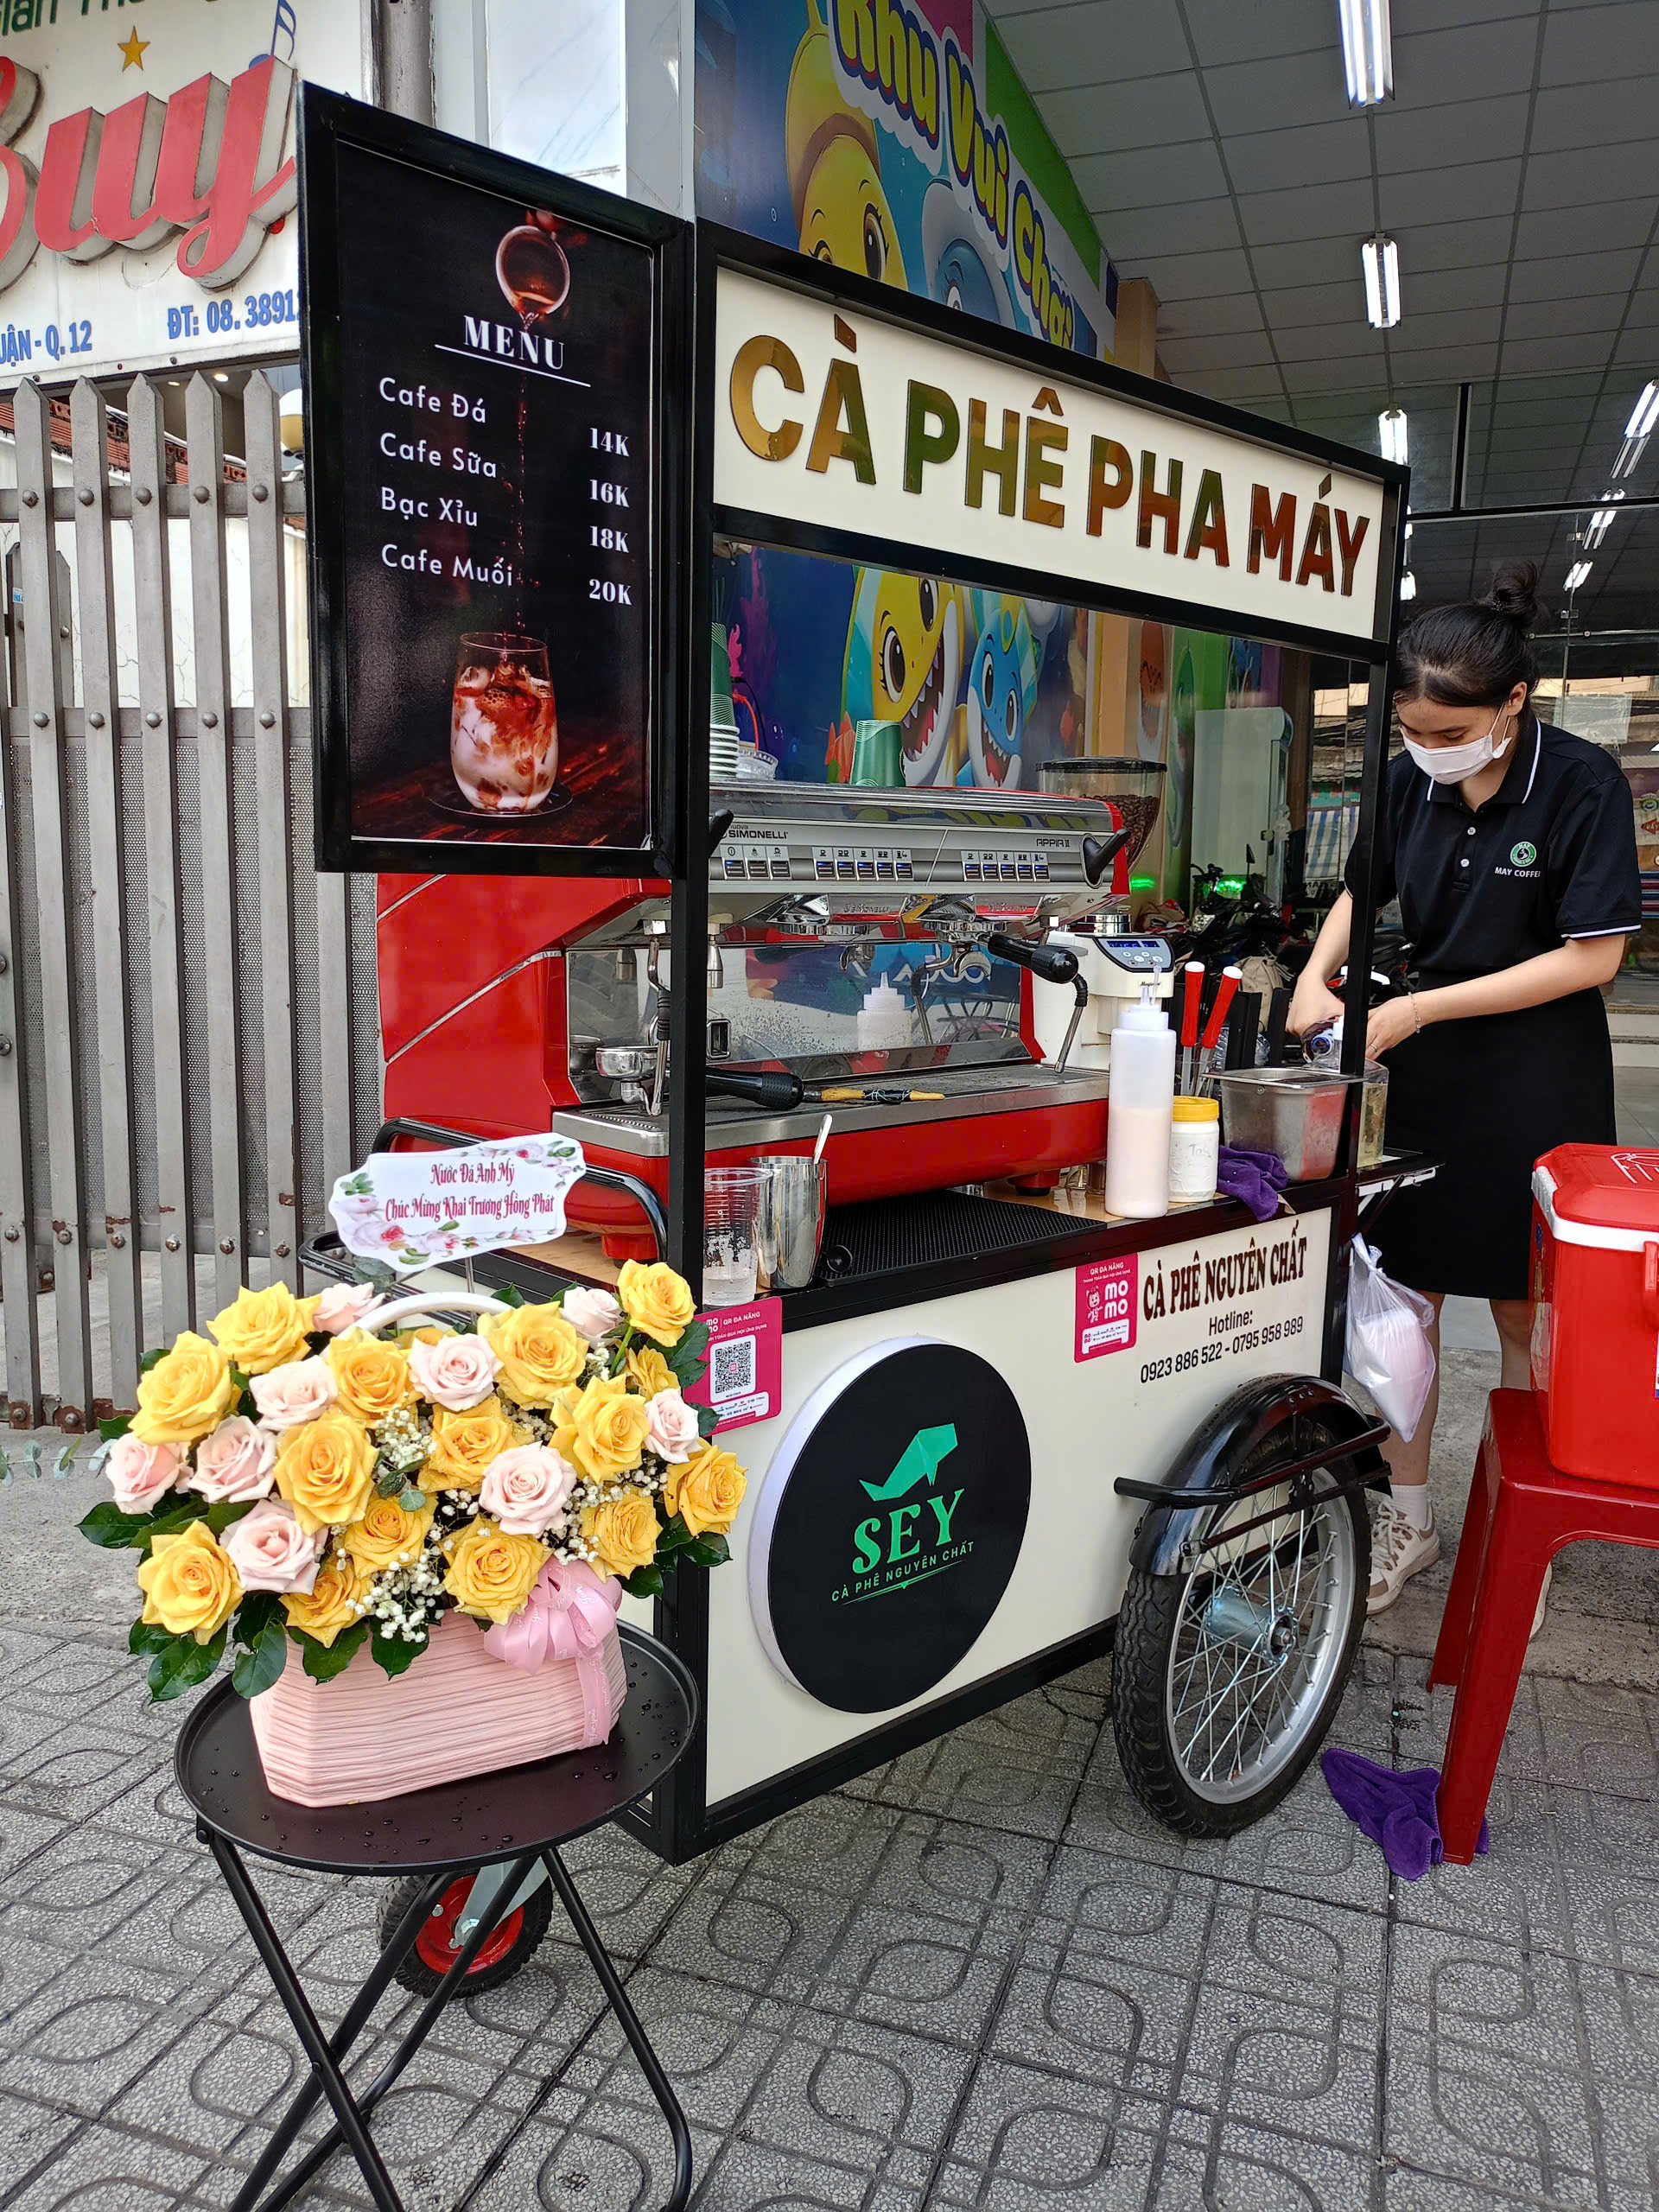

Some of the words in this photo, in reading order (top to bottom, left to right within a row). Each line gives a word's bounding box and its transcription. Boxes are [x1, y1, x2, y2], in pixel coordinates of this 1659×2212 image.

[945, 38, 1009, 251] Vui
[0, 55, 296, 278] uy
[168, 305, 200, 340] ĐT:
[463, 315, 564, 370] MENU
[379, 378, 441, 413] Cafe
[451, 393, 486, 423] Đá
[380, 433, 441, 467] Cafe
[453, 448, 497, 478] Sữa
[589, 428, 629, 457] 14K
[729, 313, 877, 486] CÀ
[903, 378, 1068, 529] PHÊ
[1086, 434, 1230, 568] PHA
[1247, 473, 1370, 597] MÁY
[381, 487, 429, 520] Bạc
[440, 498, 478, 526] Xỉu
[589, 479, 629, 507] 16K
[589, 525, 629, 553] 18K
[382, 544, 442, 575] Cafe
[453, 556, 512, 587] Muối
[588, 579, 632, 605] 20K
[728, 830, 788, 839] SIMONELLI
[1036, 838, 1064, 847] APPIA
[1495, 867, 1512, 876] MAY
[430, 1163, 457, 1185] Nước
[460, 1163, 474, 1183] Đá
[475, 1161, 496, 1184] Anh
[385, 1198, 410, 1222] Chúc
[410, 1193, 442, 1223] Mừng
[443, 1196, 467, 1220] Khai
[503, 1190, 531, 1219] Hồng
[532, 1192, 555, 1214] Phát
[1143, 1259, 1166, 1321] CÀ
[1170, 1250, 1200, 1313] PHÊ
[1205, 1236, 1268, 1305] NGUYÊN
[1270, 1219, 1306, 1287] CHẤT
[1209, 1309, 1253, 1336] Hotline:
[1141, 1357, 1173, 1383] 0923
[1175, 1349, 1198, 1373] 886
[1201, 1342, 1222, 1364] 522
[1232, 1330, 1259, 1355] 0795
[1262, 1323, 1281, 1345] 958
[1284, 1316, 1303, 1338] 989
[852, 1488, 965, 1573] SEY
[831, 1584, 849, 1601] CÀ
[855, 1573, 880, 1592] PHÊ
[886, 1555, 937, 1582] NGUYÊN
[942, 1541, 974, 1560] CHẤT
